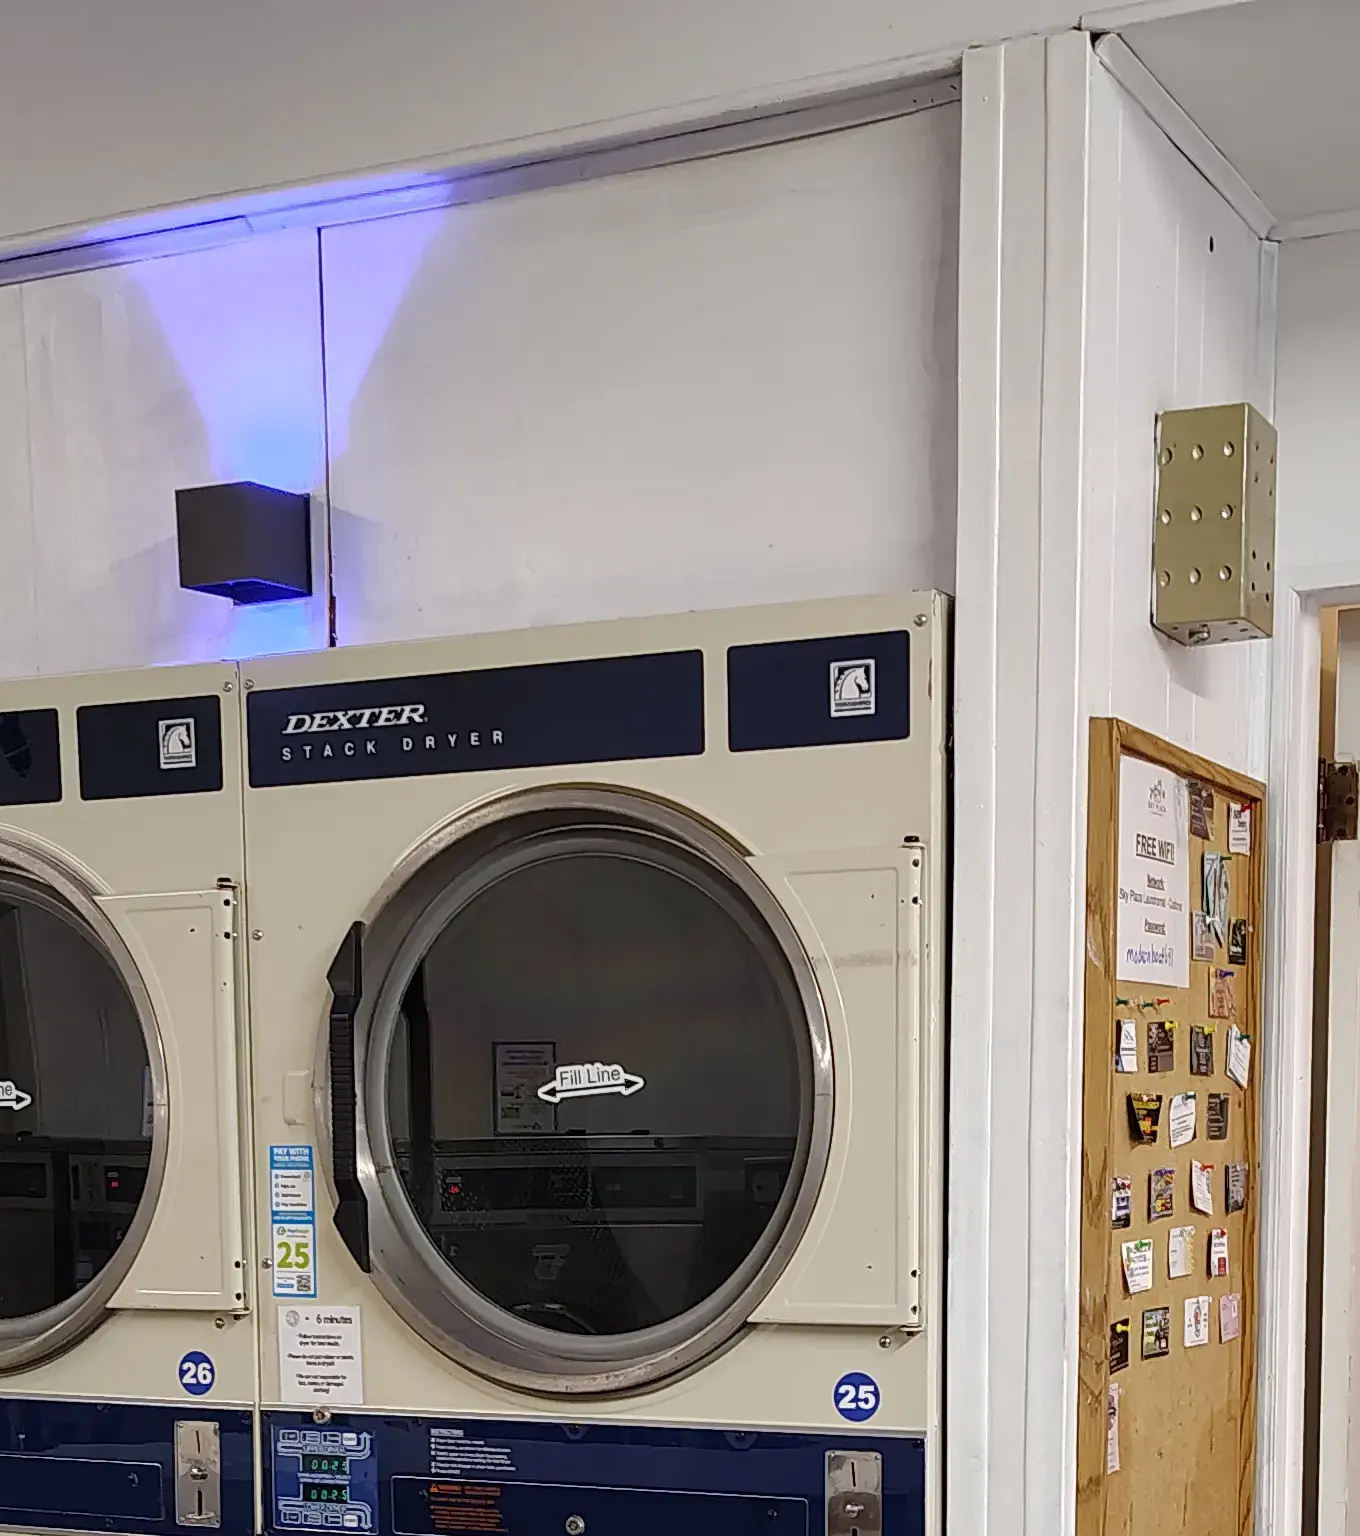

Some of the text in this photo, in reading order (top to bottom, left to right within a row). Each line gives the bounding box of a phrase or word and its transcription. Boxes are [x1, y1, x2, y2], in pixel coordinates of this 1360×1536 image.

[282, 703, 430, 734] DEXTER
[282, 729, 504, 761] STACK DRYER
[1136, 832, 1156, 856] FREE
[559, 1066, 621, 1087] Fill Line
[276, 1241, 310, 1269] 25
[181, 1362, 213, 1385] 26
[838, 1385, 876, 1410] 25
